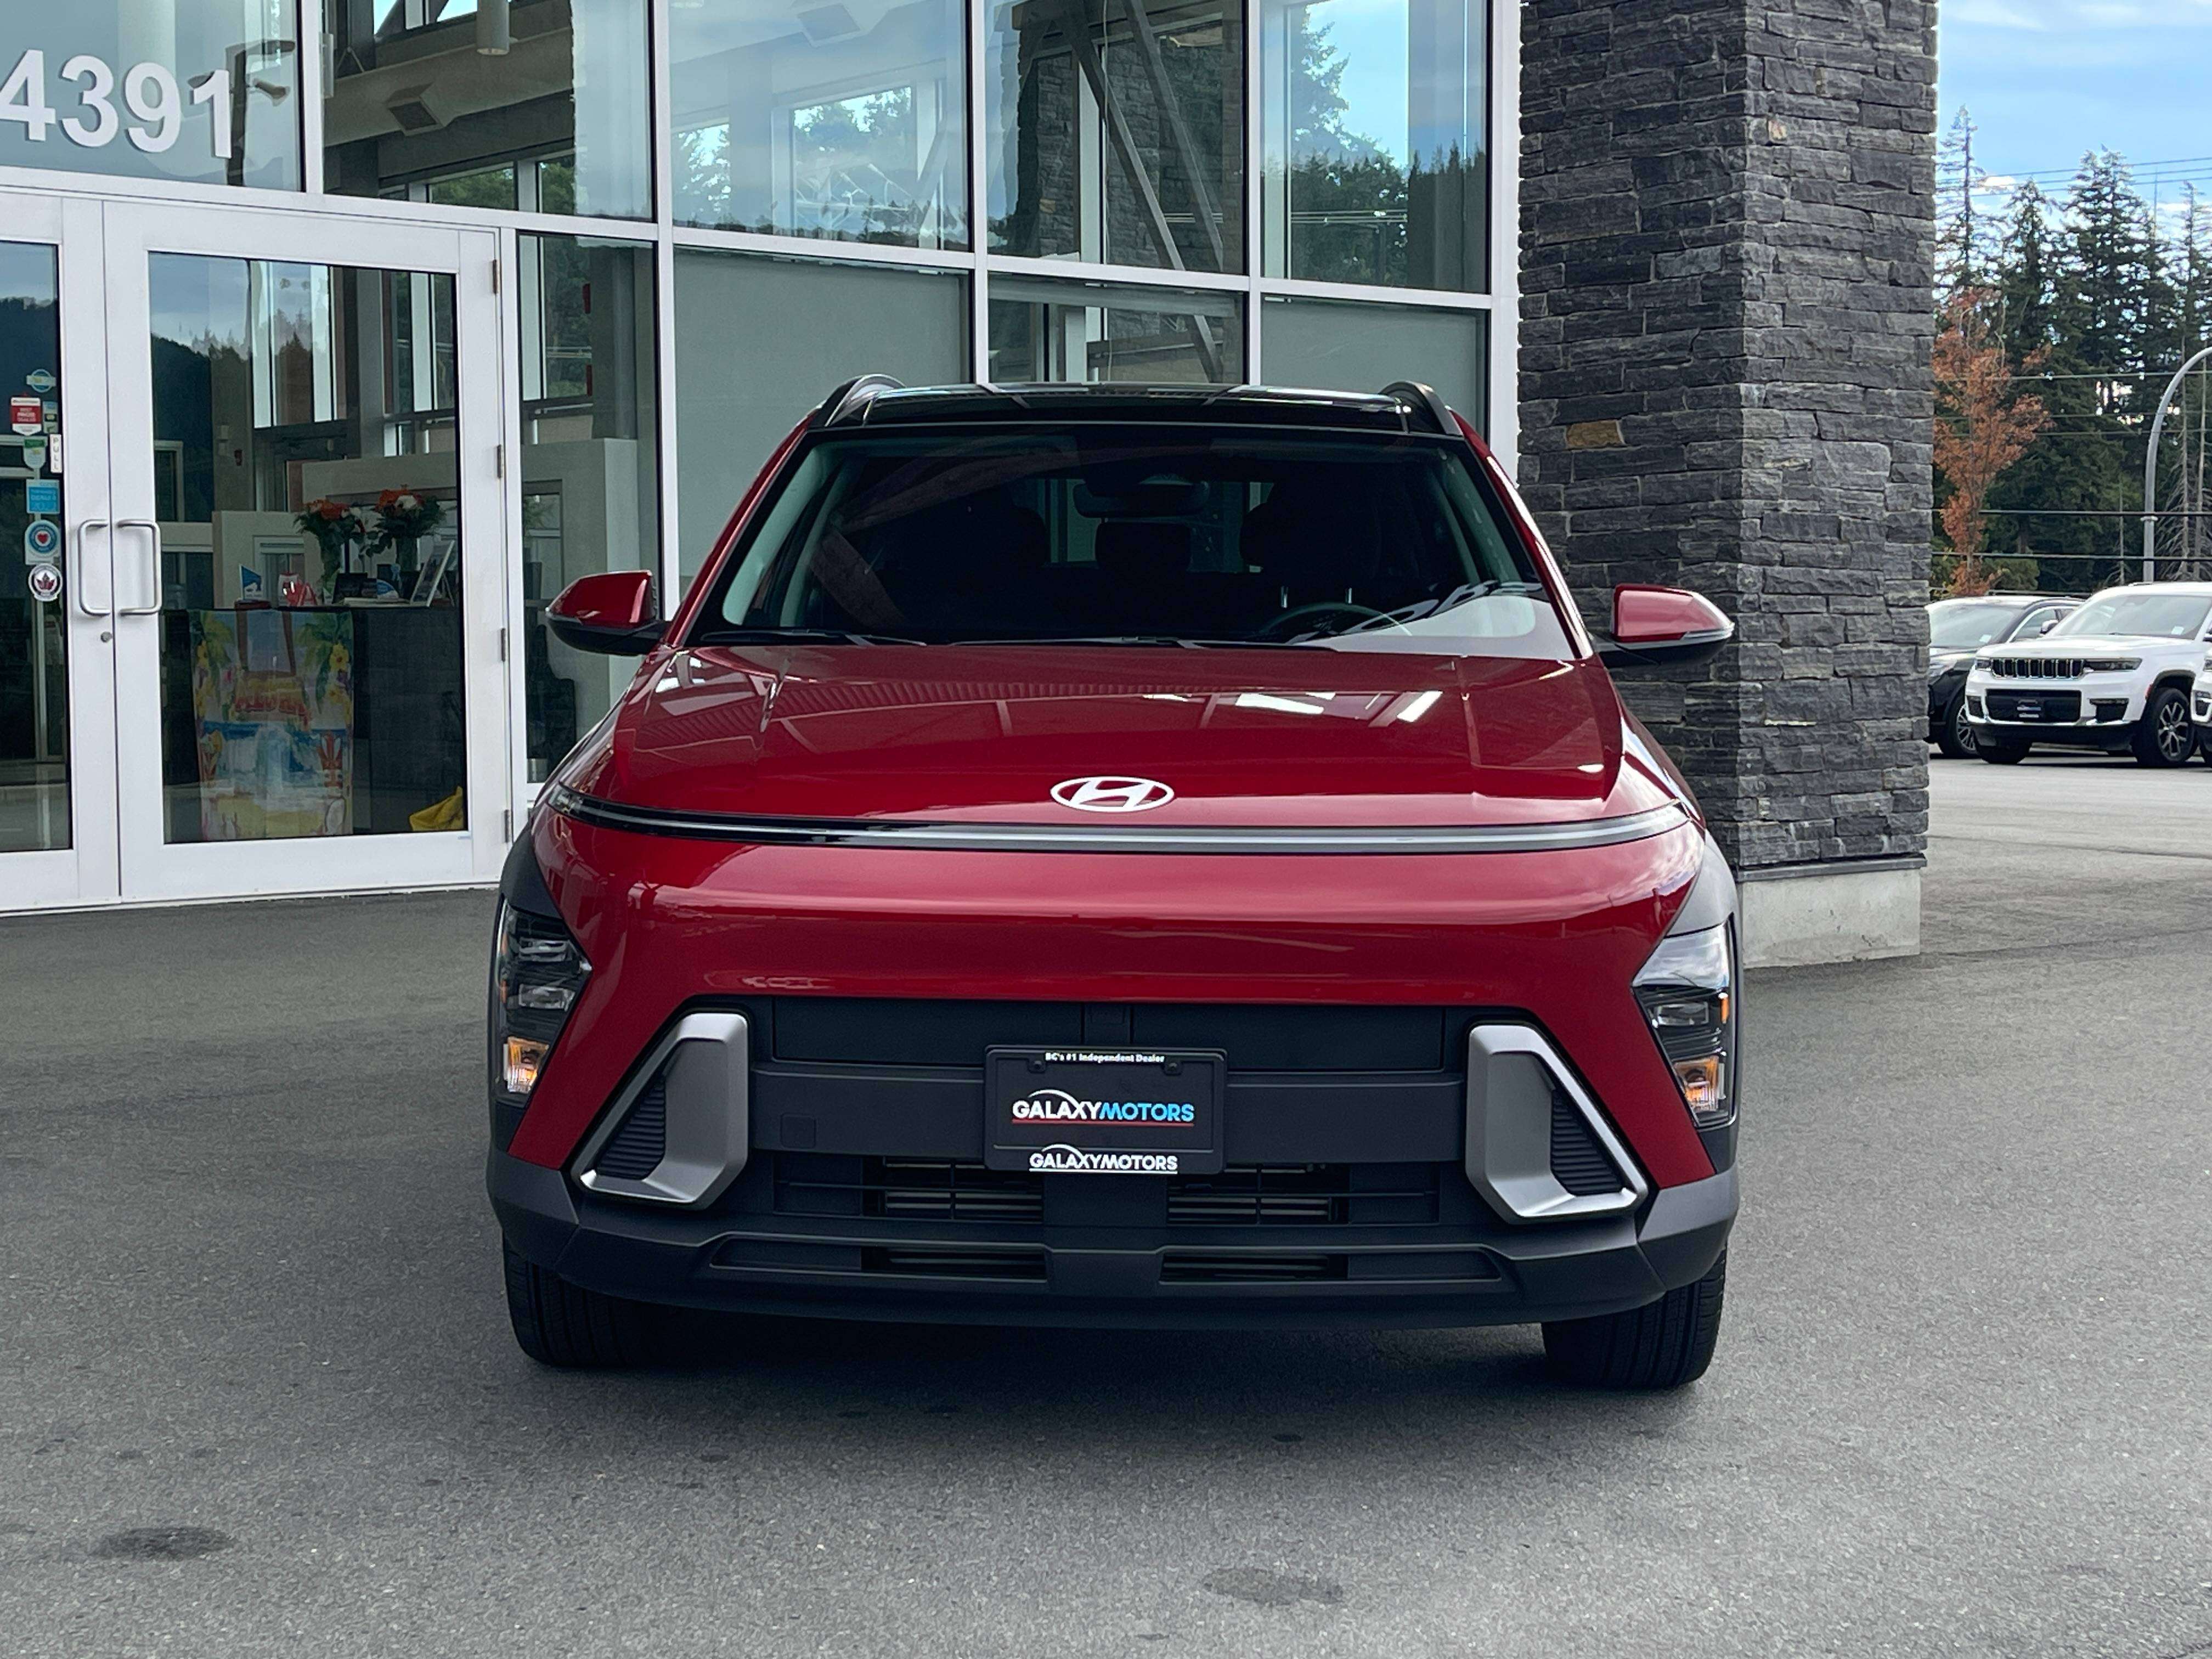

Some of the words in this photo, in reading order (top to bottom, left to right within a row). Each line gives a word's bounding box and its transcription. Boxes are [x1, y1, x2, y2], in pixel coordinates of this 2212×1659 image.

[0, 49, 232, 159] 4391
[1045, 1052, 1064, 1061] BC's
[1066, 1053, 1076, 1061] #1
[1079, 1053, 1135, 1063] Independent
[1136, 1054, 1165, 1062] Dealer
